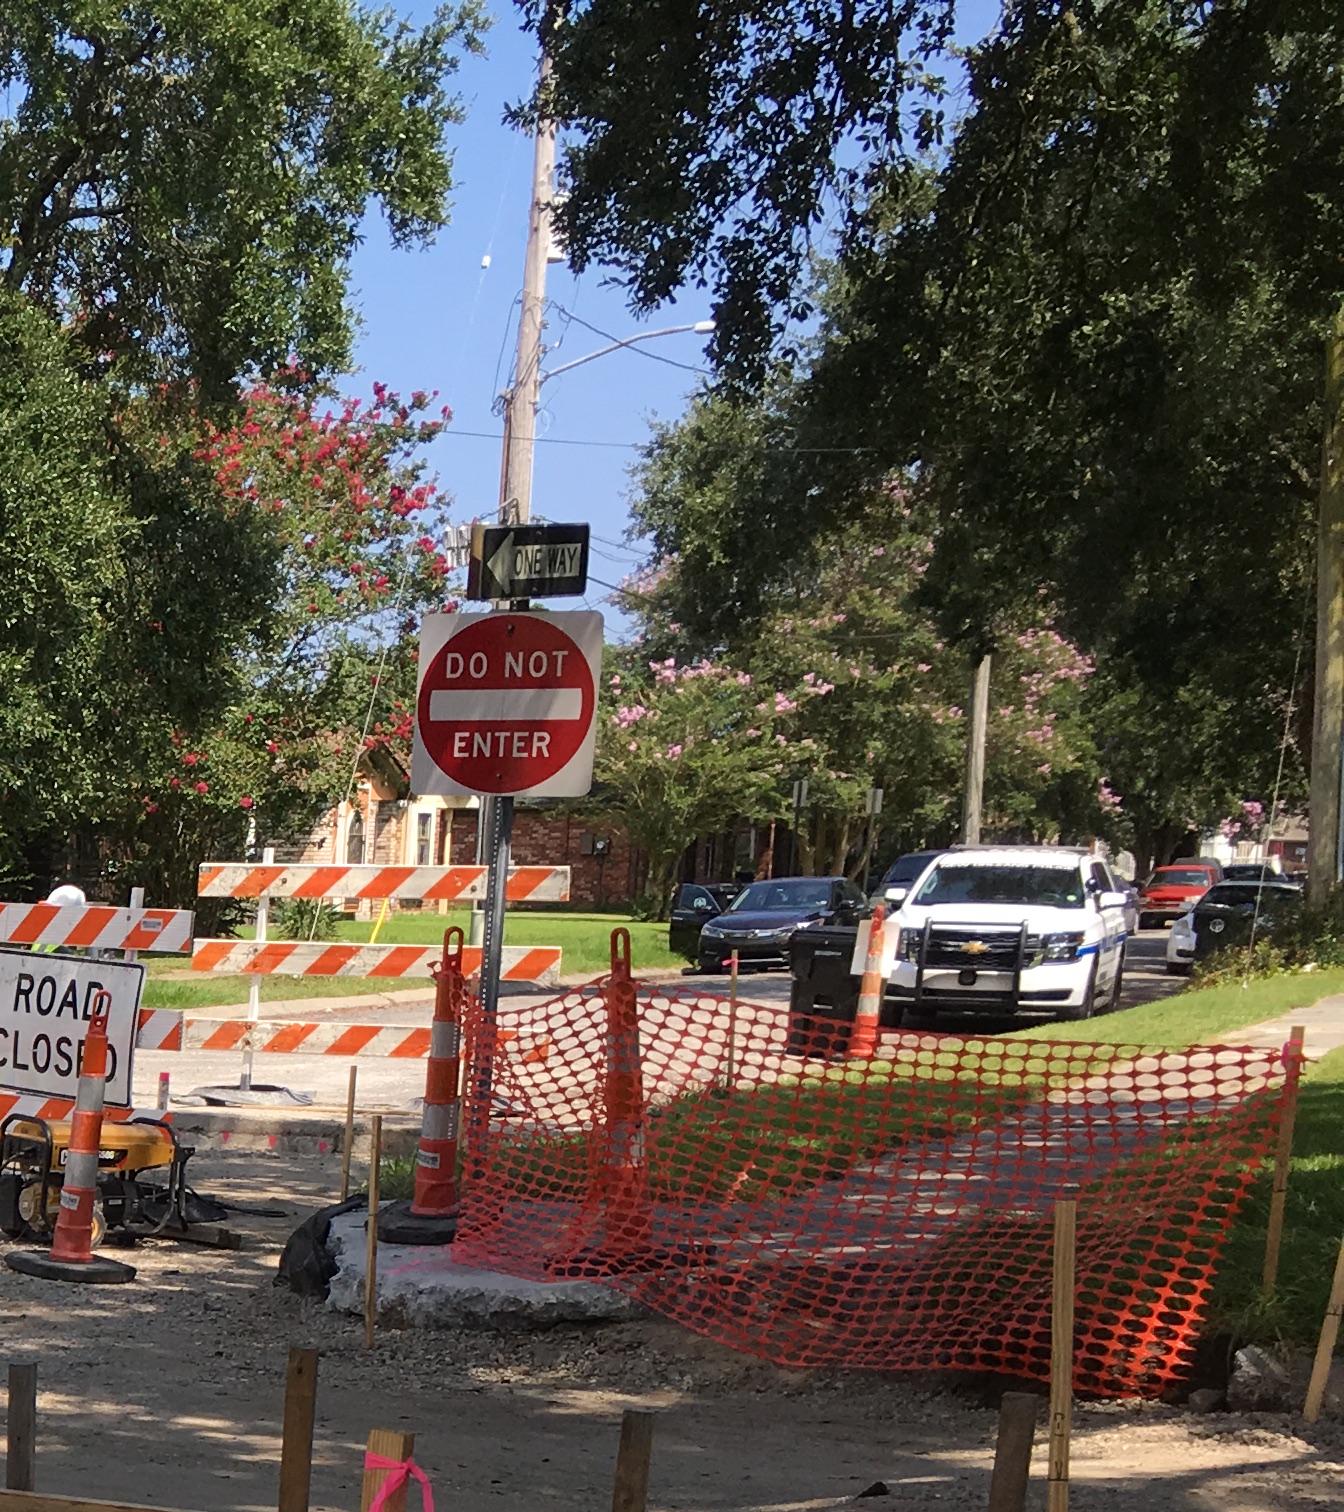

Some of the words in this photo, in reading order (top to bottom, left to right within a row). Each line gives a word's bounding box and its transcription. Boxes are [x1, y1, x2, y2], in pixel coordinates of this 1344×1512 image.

[513, 547, 540, 575] ONE
[547, 545, 578, 574] WAY
[445, 651, 488, 680] DO
[504, 650, 569, 678] NOT
[453, 731, 551, 758] ENTER
[13, 972, 104, 1021] ROAD
